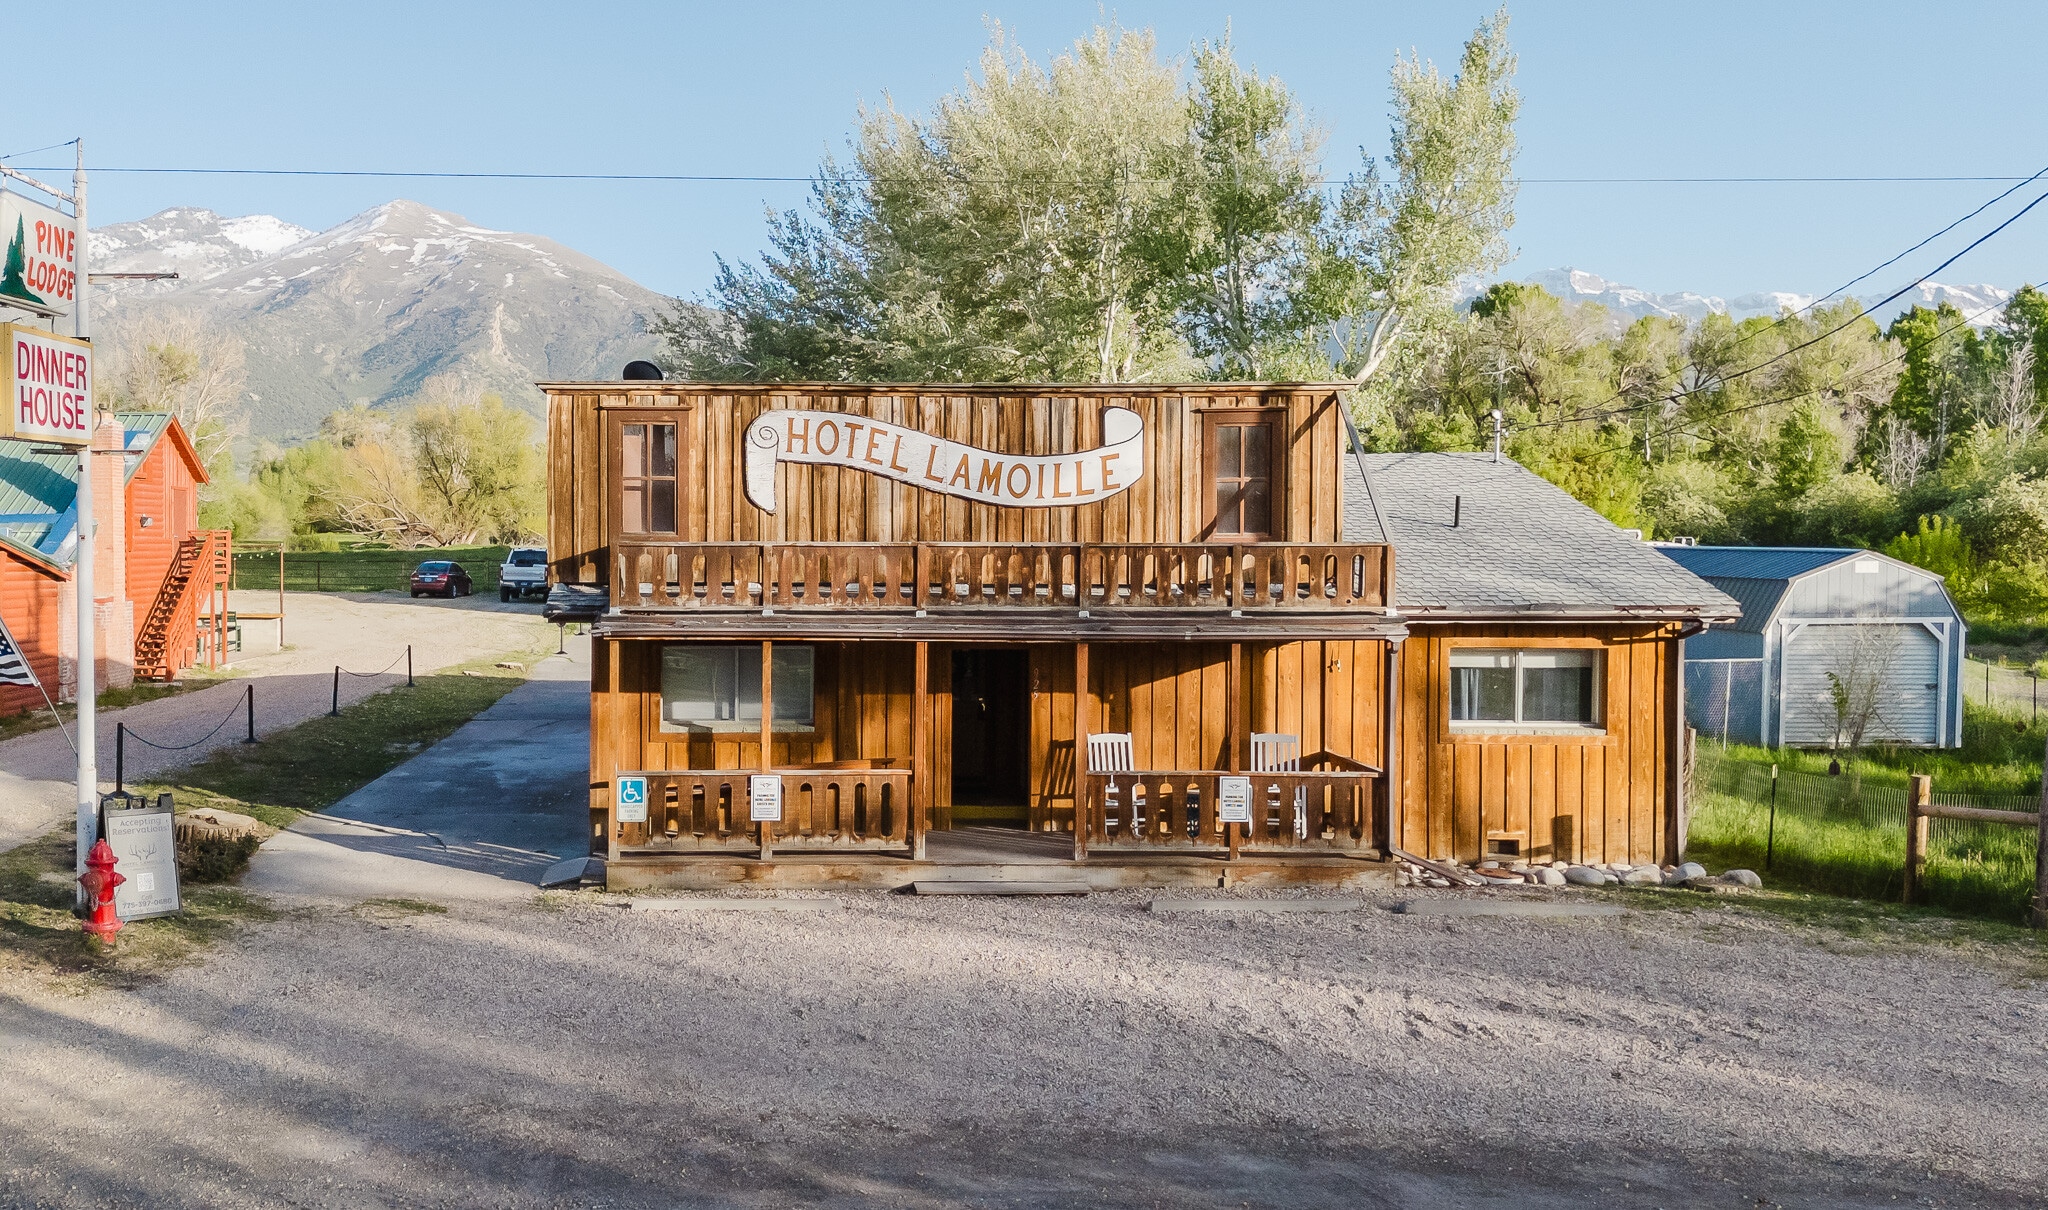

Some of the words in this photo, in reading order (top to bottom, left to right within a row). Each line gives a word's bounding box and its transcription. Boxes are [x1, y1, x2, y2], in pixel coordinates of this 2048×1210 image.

[35, 220, 75, 262] PINE
[27, 256, 75, 301] LODGE
[17, 341, 87, 391] DINNER
[20, 385, 86, 431] HOUSE
[786, 417, 909, 473] HOTEL
[923, 444, 1121, 499] LAMOILLE
[120, 817, 162, 828] Accepting
